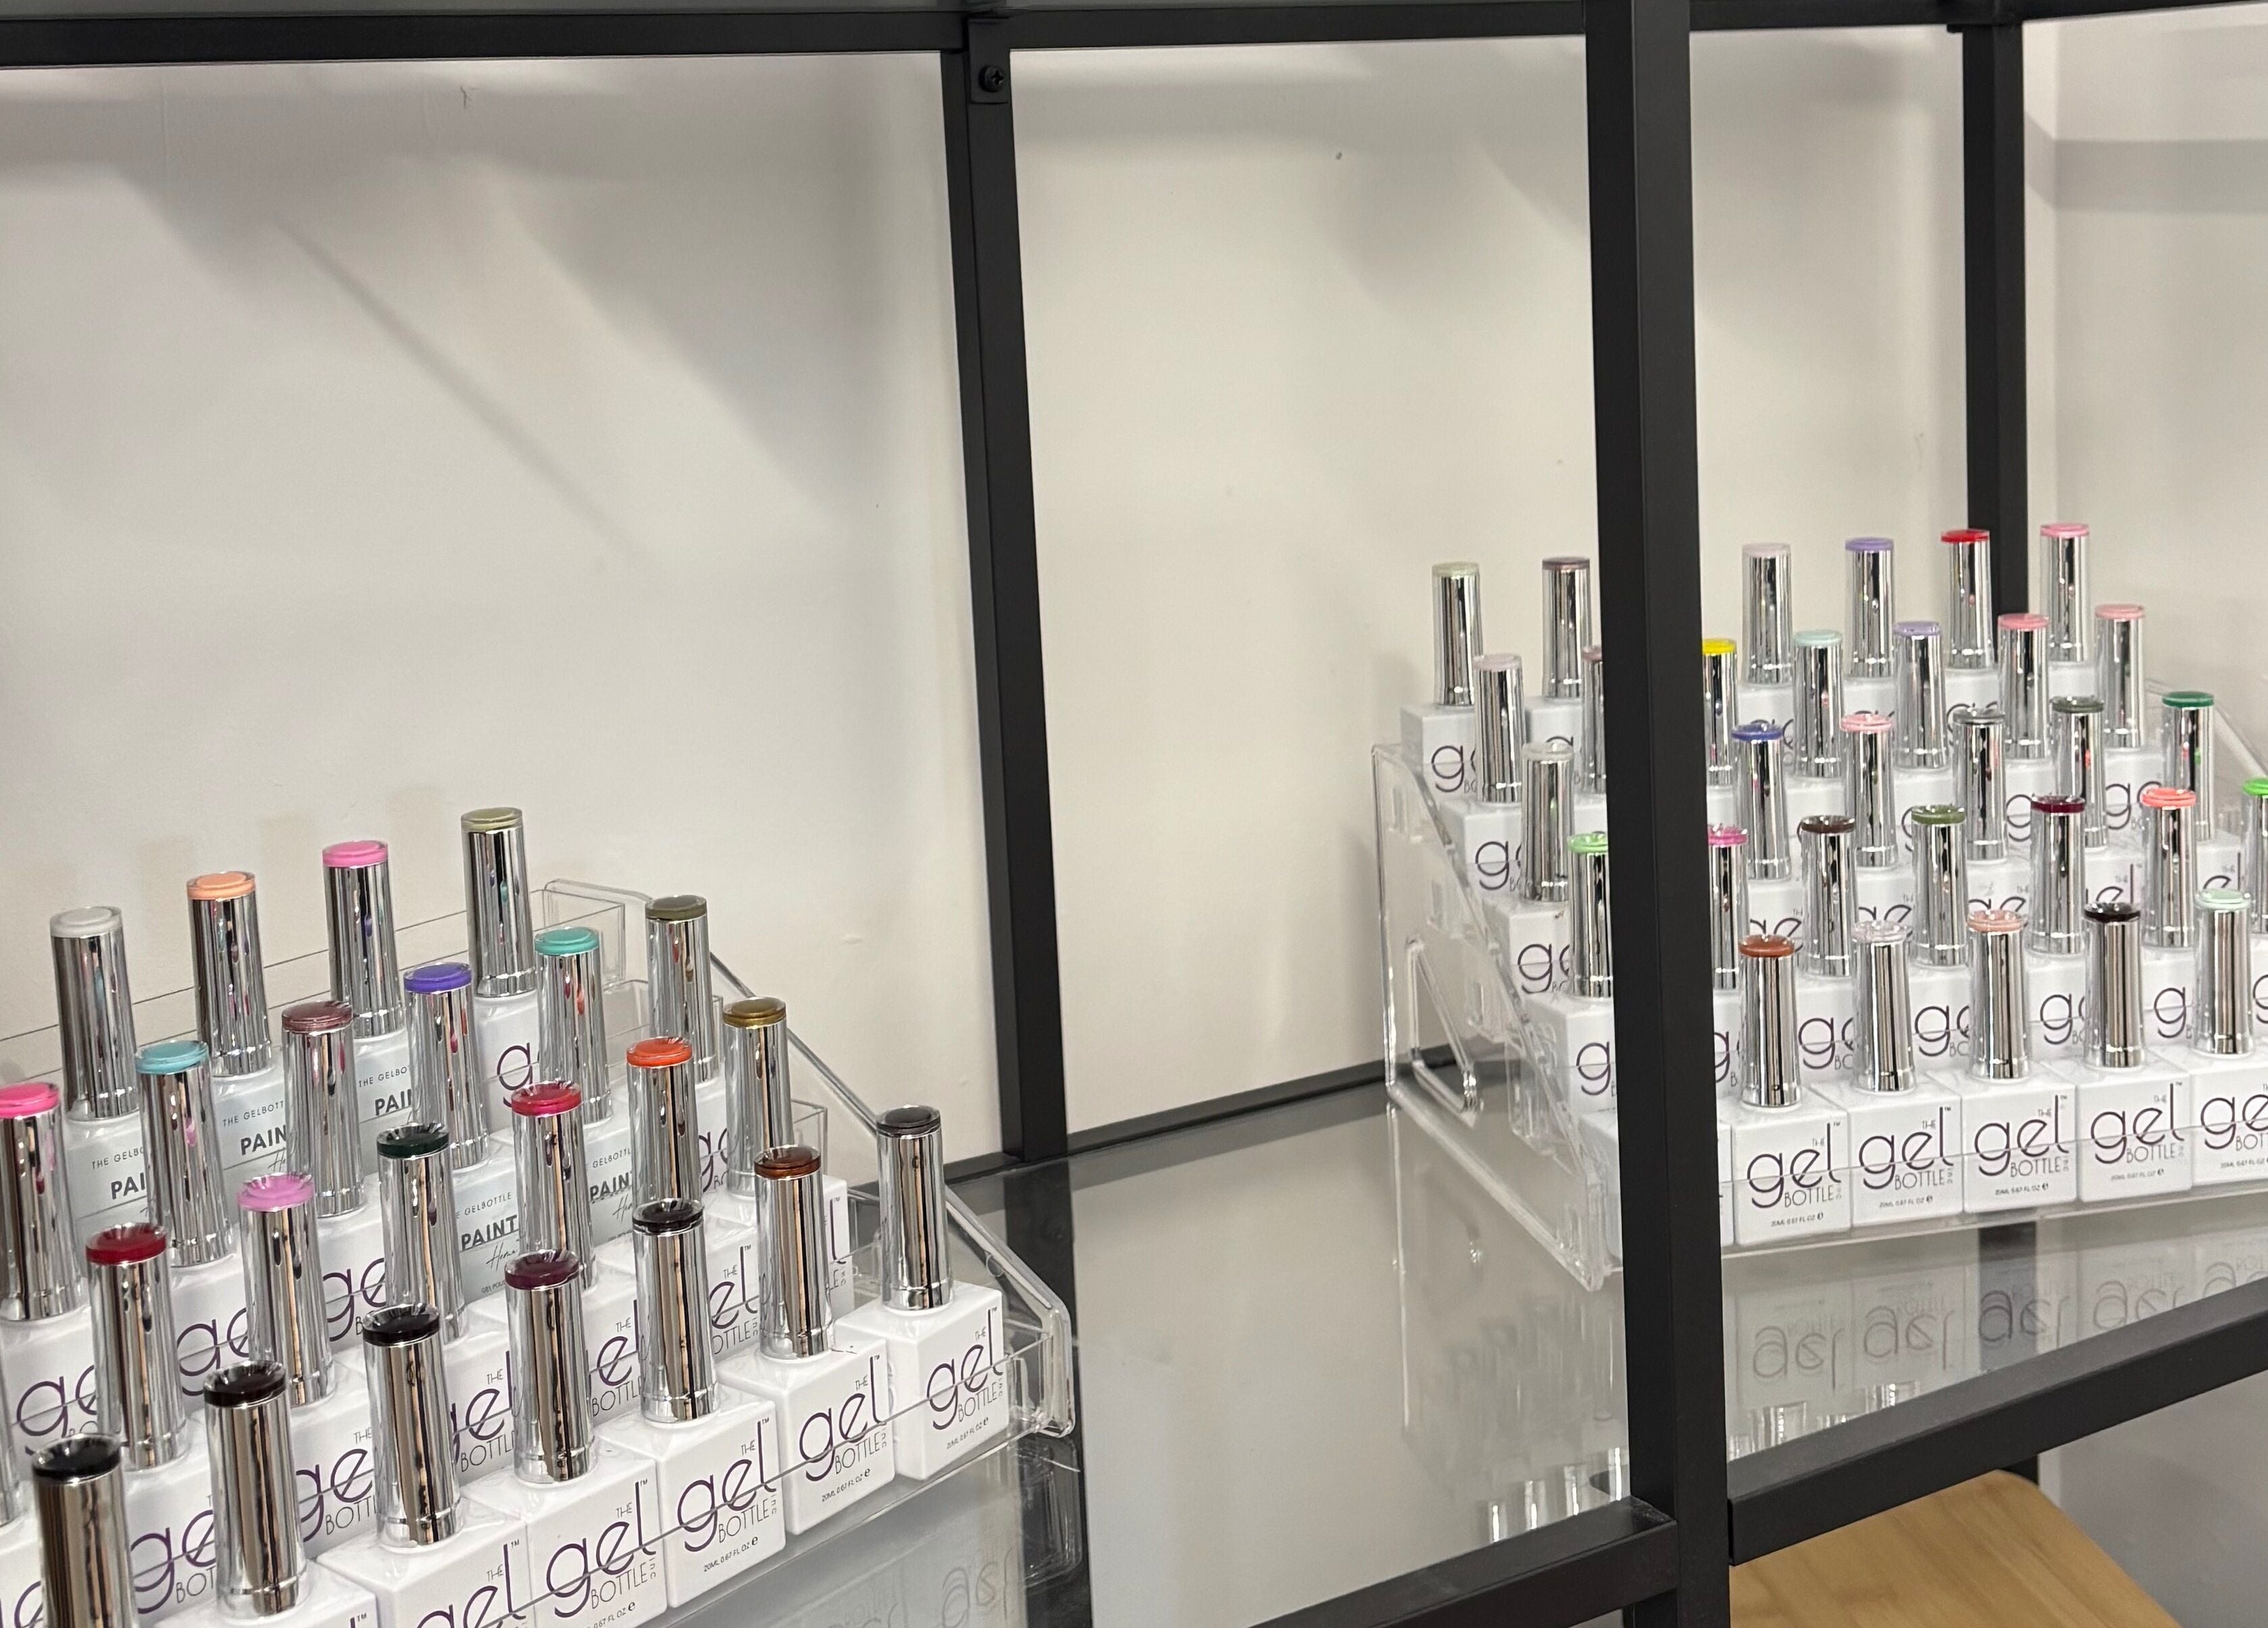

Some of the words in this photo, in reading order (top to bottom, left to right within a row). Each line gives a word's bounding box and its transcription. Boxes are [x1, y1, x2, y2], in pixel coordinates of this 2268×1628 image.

[358, 1077, 374, 1088] THE
[222, 1115, 238, 1127] THE
[1974, 1094, 2069, 1177] gel
[2091, 1083, 2184, 1164] gel
[1859, 1106, 1954, 1190] gel
[2126, 1142, 2176, 1164] BOTTLE
[2236, 1133, 2268, 1152] BOT
[92, 1157, 109, 1170] THE
[1747, 1122, 1842, 1208] gel
[1894, 1168, 1945, 1190] BOTTLE
[2011, 1156, 2061, 1178] BOTTLE
[589, 1170, 632, 1202] PAIN
[1784, 1185, 1834, 1208] BOTTLE
[461, 1214, 518, 1251] PAINT
[709, 1246, 758, 1329] el
[723, 1265, 738, 1279] THE
[615, 1318, 632, 1333] THE
[713, 1320, 751, 1355] OTTLE
[589, 1299, 639, 1393] el
[486, 1368, 504, 1385] THE
[927, 1309, 1003, 1430] gel
[451, 1350, 513, 1464] el
[799, 1356, 887, 1481] gel
[958, 1381, 998, 1423] BOTTLE
[740, 1439, 756, 1456] THE
[835, 1431, 881, 1475] BOTTLE
[677, 1421, 777, 1552] gel
[615, 1502, 632, 1519] THE
[718, 1498, 770, 1544] BOTTLE
[546, 1481, 657, 1618] gel
[486, 1564, 504, 1582] THE
[590, 1562, 648, 1609] BOTTLE
